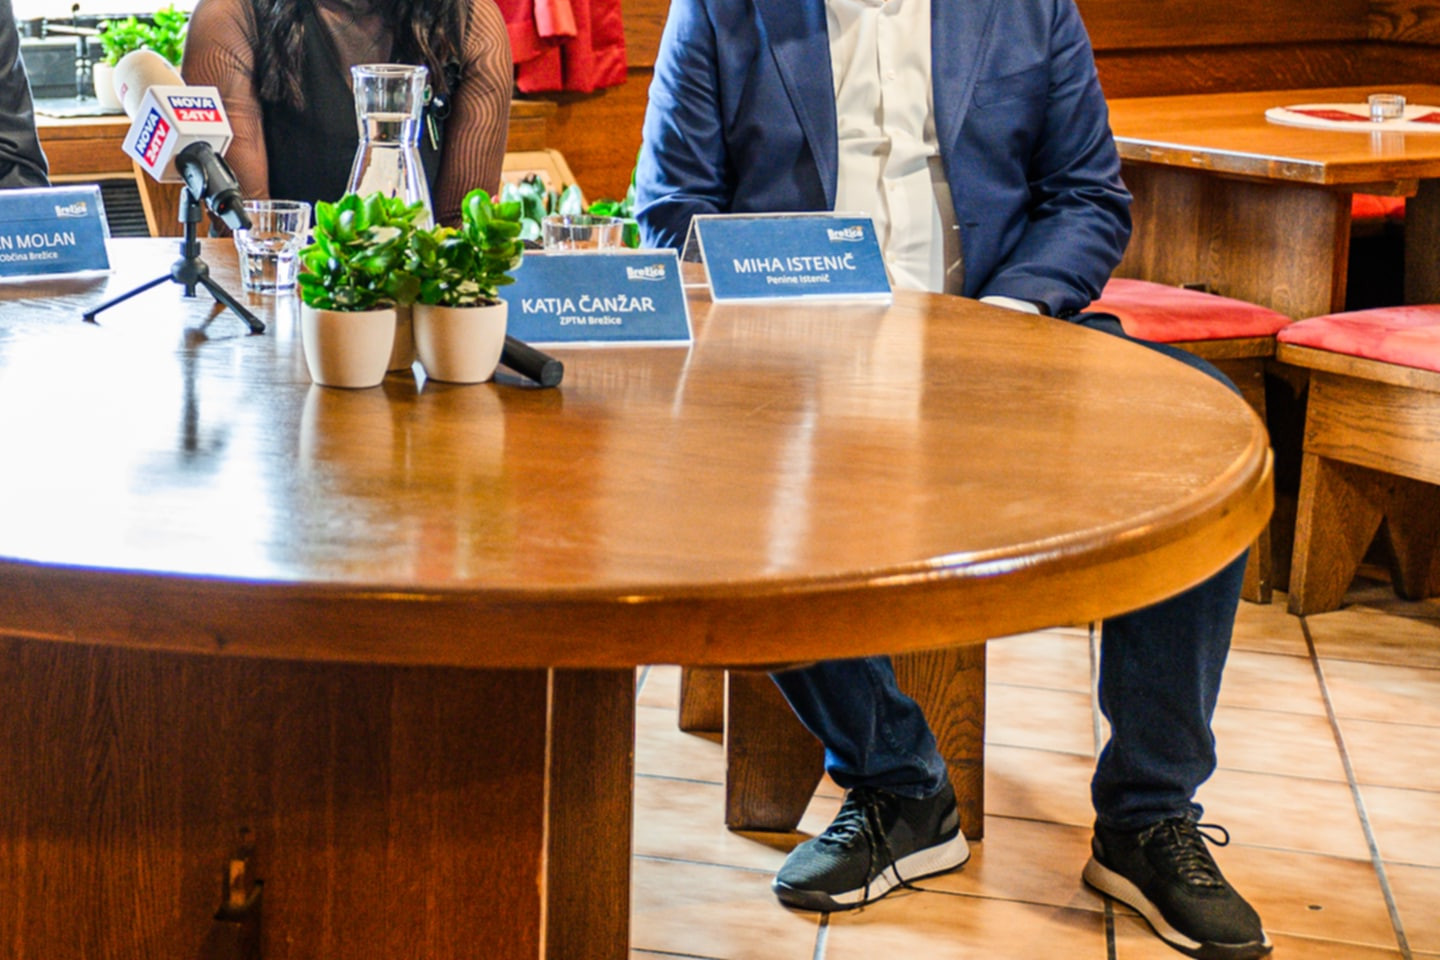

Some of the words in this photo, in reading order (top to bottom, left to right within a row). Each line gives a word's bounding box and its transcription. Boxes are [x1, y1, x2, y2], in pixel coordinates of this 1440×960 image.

[170, 96, 215, 108] NOVA
[178, 109, 216, 121] 24TV
[135, 111, 160, 154] NOVA
[145, 123, 168, 163] 24TV
[16, 231, 76, 249] MOLAN
[29, 251, 58, 261] Brežice
[732, 258, 785, 274] MIHA
[786, 252, 856, 272] ISTENIČ
[766, 275, 798, 285] Penine
[799, 274, 830, 283] Istenič
[521, 297, 576, 315] KATJA
[578, 294, 656, 313] ČANŽAR
[560, 316, 587, 327] ZPTM
[588, 315, 622, 325] Brežice
